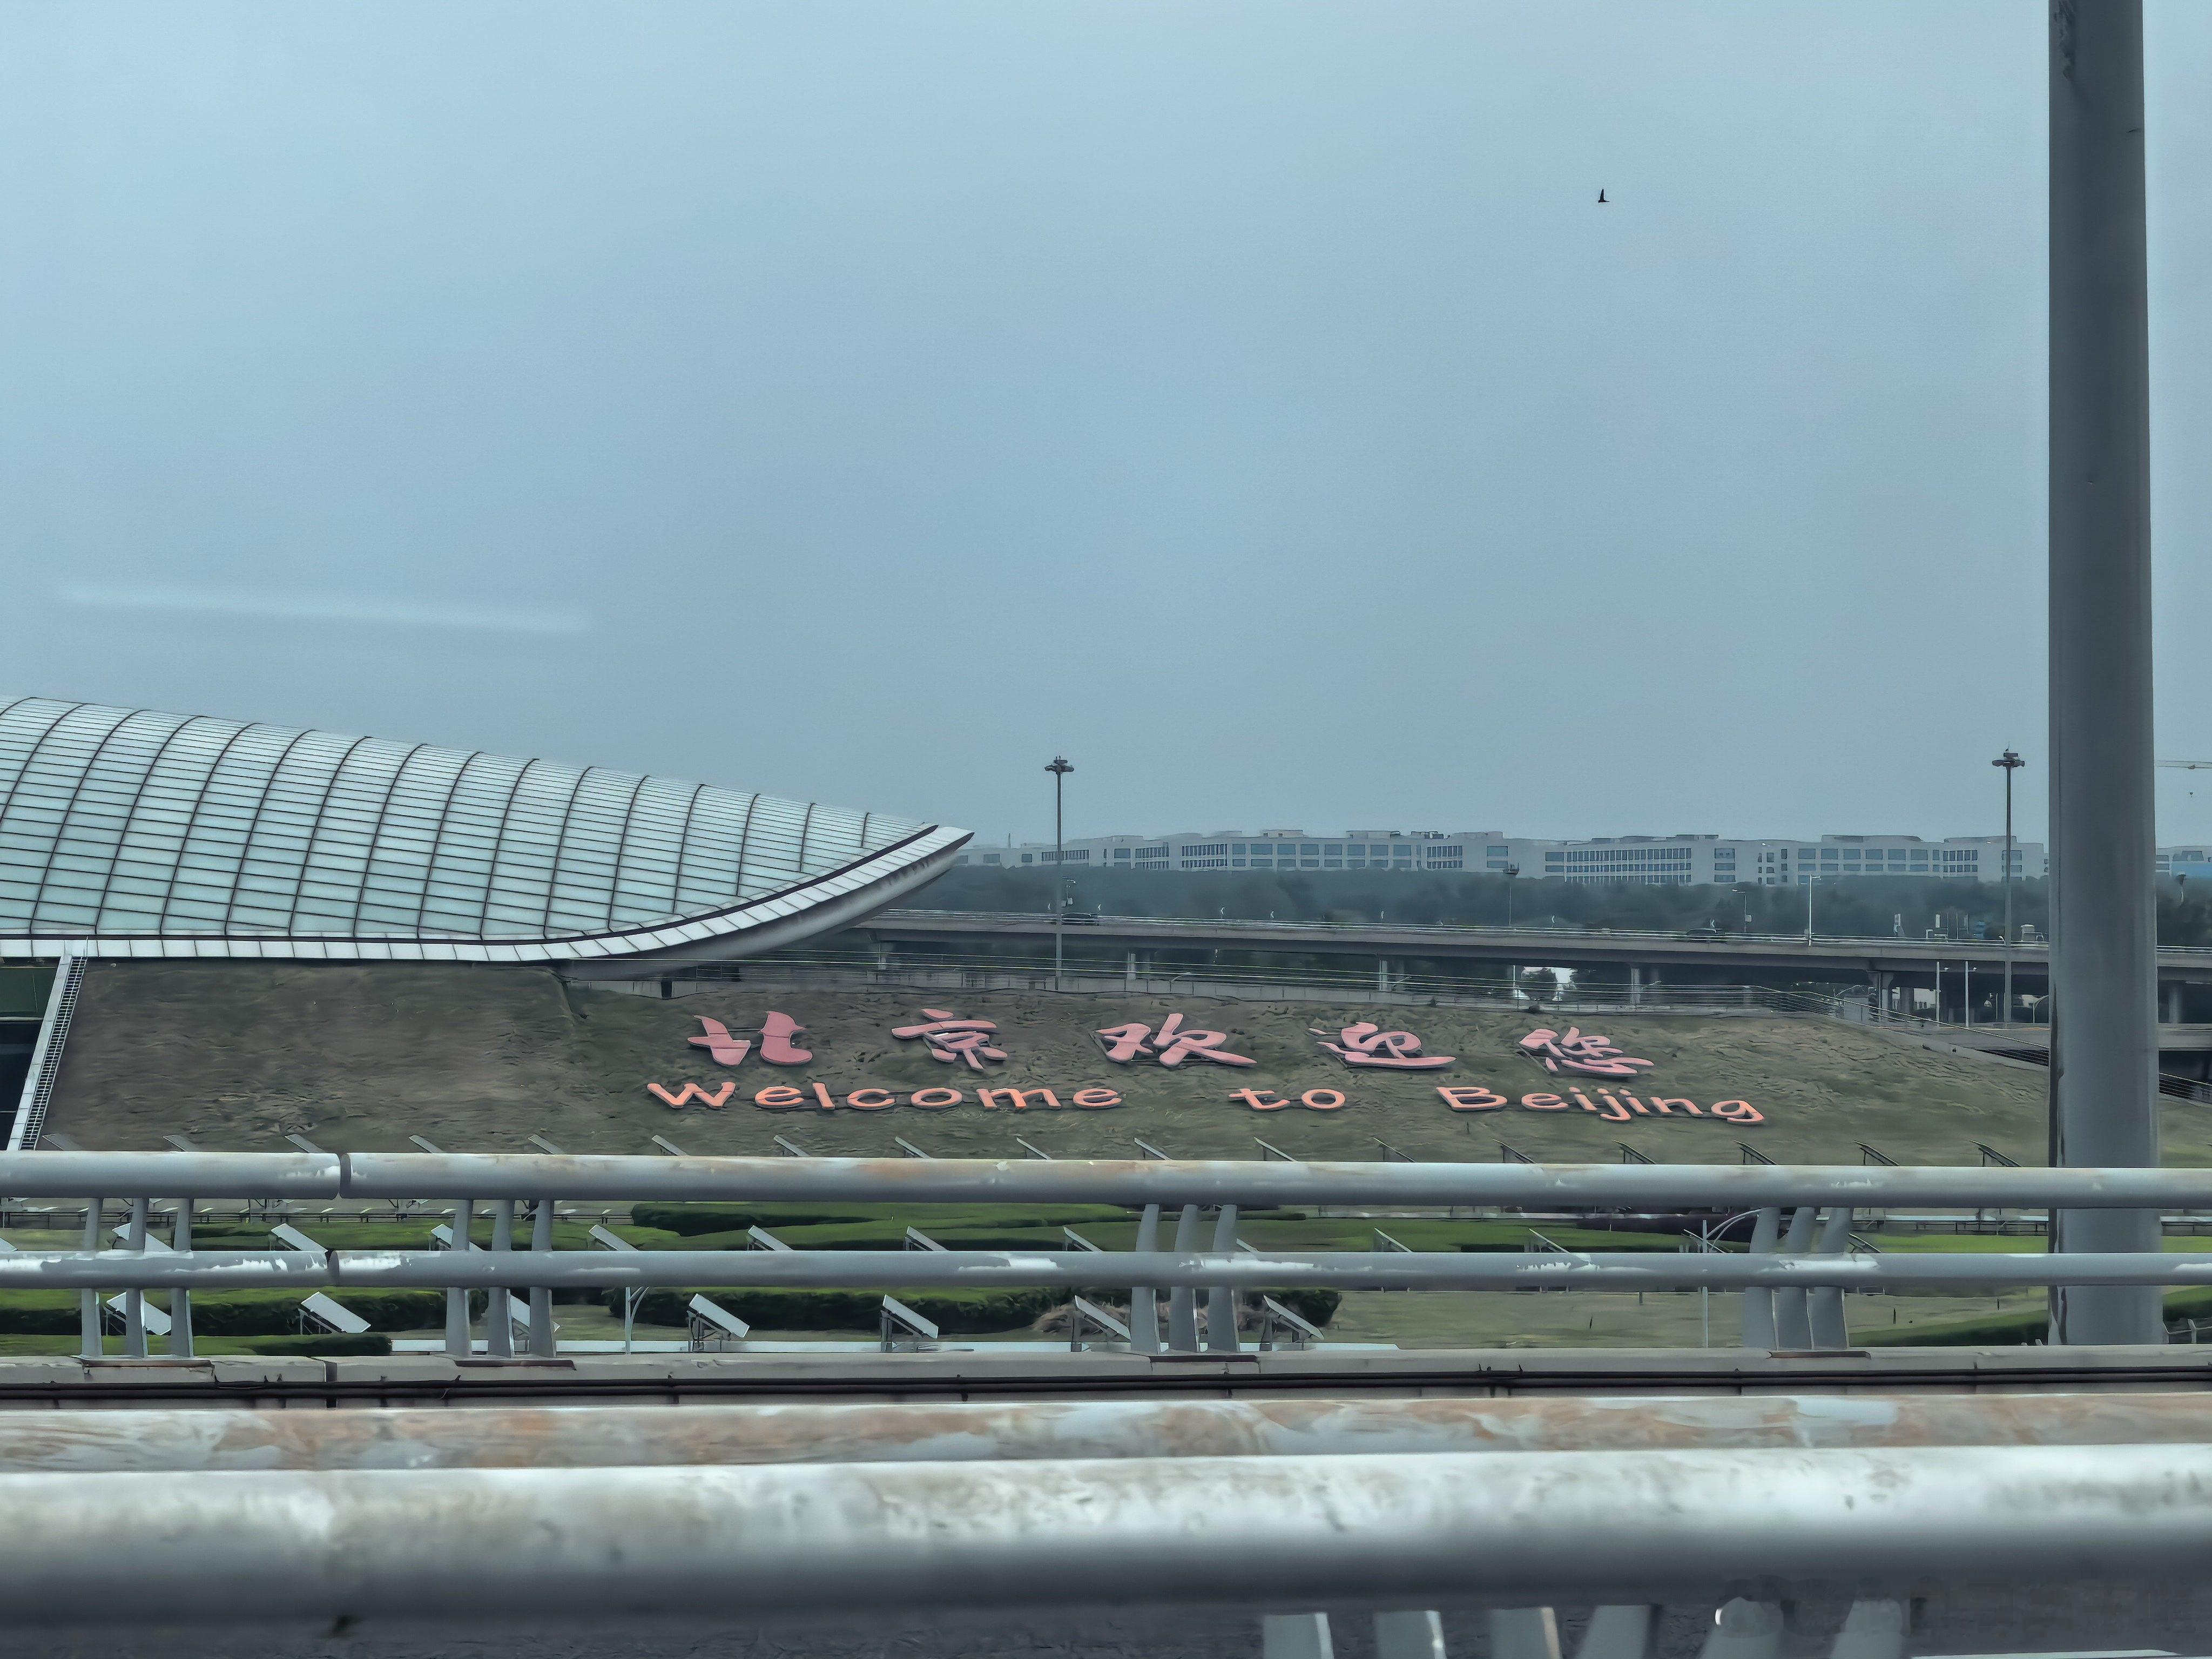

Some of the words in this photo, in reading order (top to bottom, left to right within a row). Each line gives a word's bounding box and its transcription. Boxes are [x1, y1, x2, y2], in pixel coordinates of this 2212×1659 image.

[687, 1008, 1655, 1077] 北京欢迎您
[646, 1081, 1123, 1110] Welcome
[1227, 1087, 1348, 1111] to
[1435, 1085, 1766, 1125] Beijing
